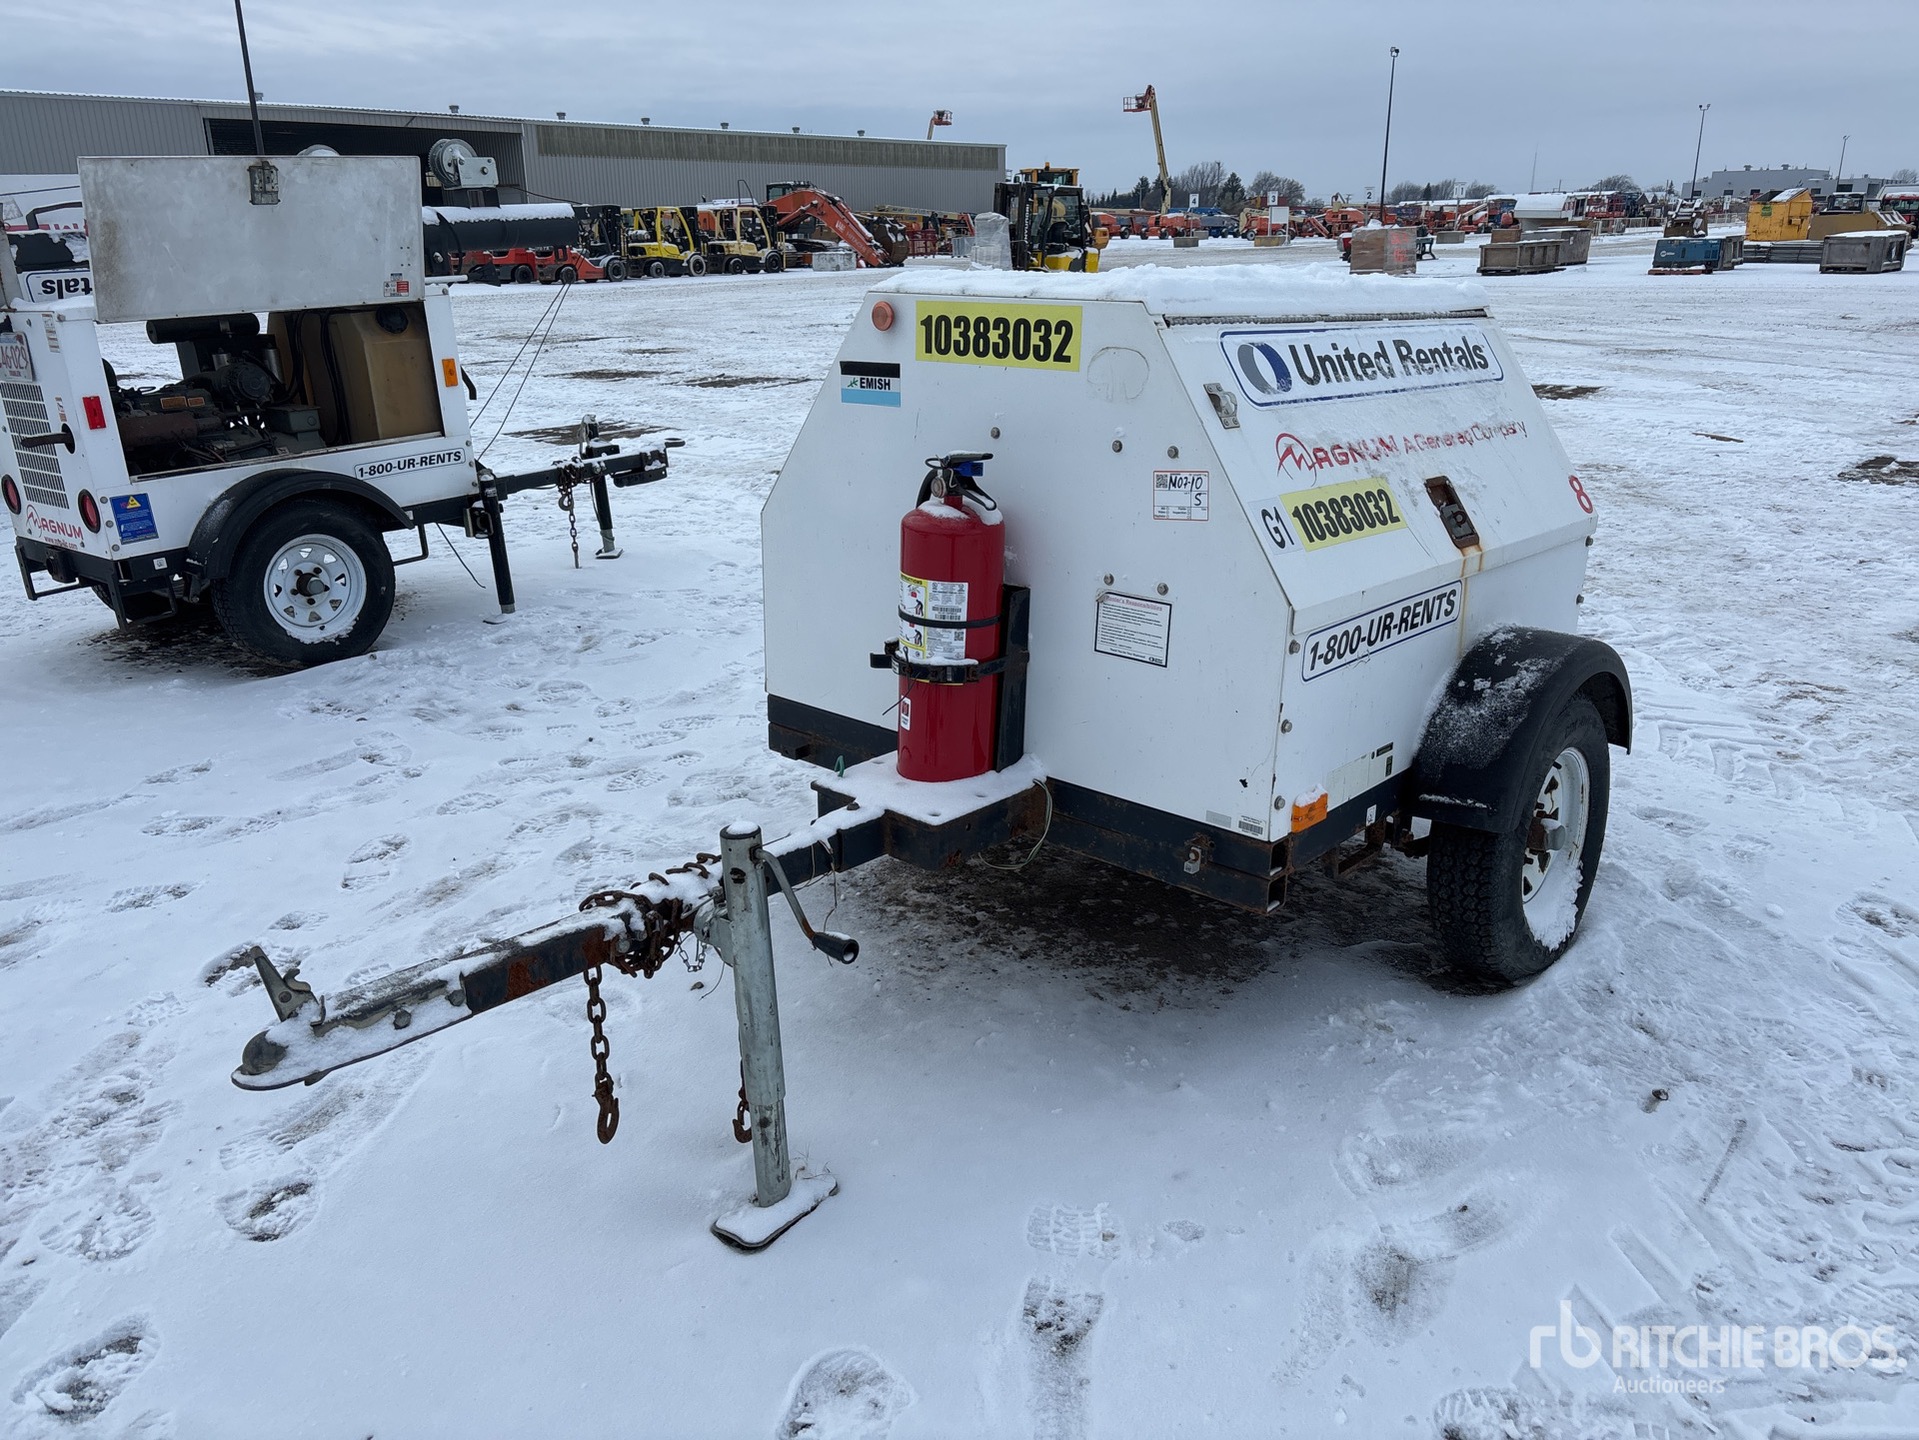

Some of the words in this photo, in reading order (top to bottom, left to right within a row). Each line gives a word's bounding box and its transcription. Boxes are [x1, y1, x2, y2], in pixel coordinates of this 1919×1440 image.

[1191, 197, 1197, 205] 4
[1271, 195, 1276, 203] 3
[1366, 191, 1372, 200] 2
[41, 277, 93, 299] tals
[920, 314, 1074, 363] 10383032
[1288, 340, 1395, 386] United
[1393, 336, 1489, 376] Rentals
[859, 377, 891, 391] EMISH
[358, 451, 461, 478] 1-800-UR-RENTS
[1276, 433, 1398, 476] MAGNUM
[1569, 475, 1593, 514] 8
[26, 504, 84, 540] MAGNUM
[1261, 507, 1295, 549] G1
[1292, 488, 1401, 544] 10383032
[1309, 589, 1457, 671] 1-800-UR-RENTS
